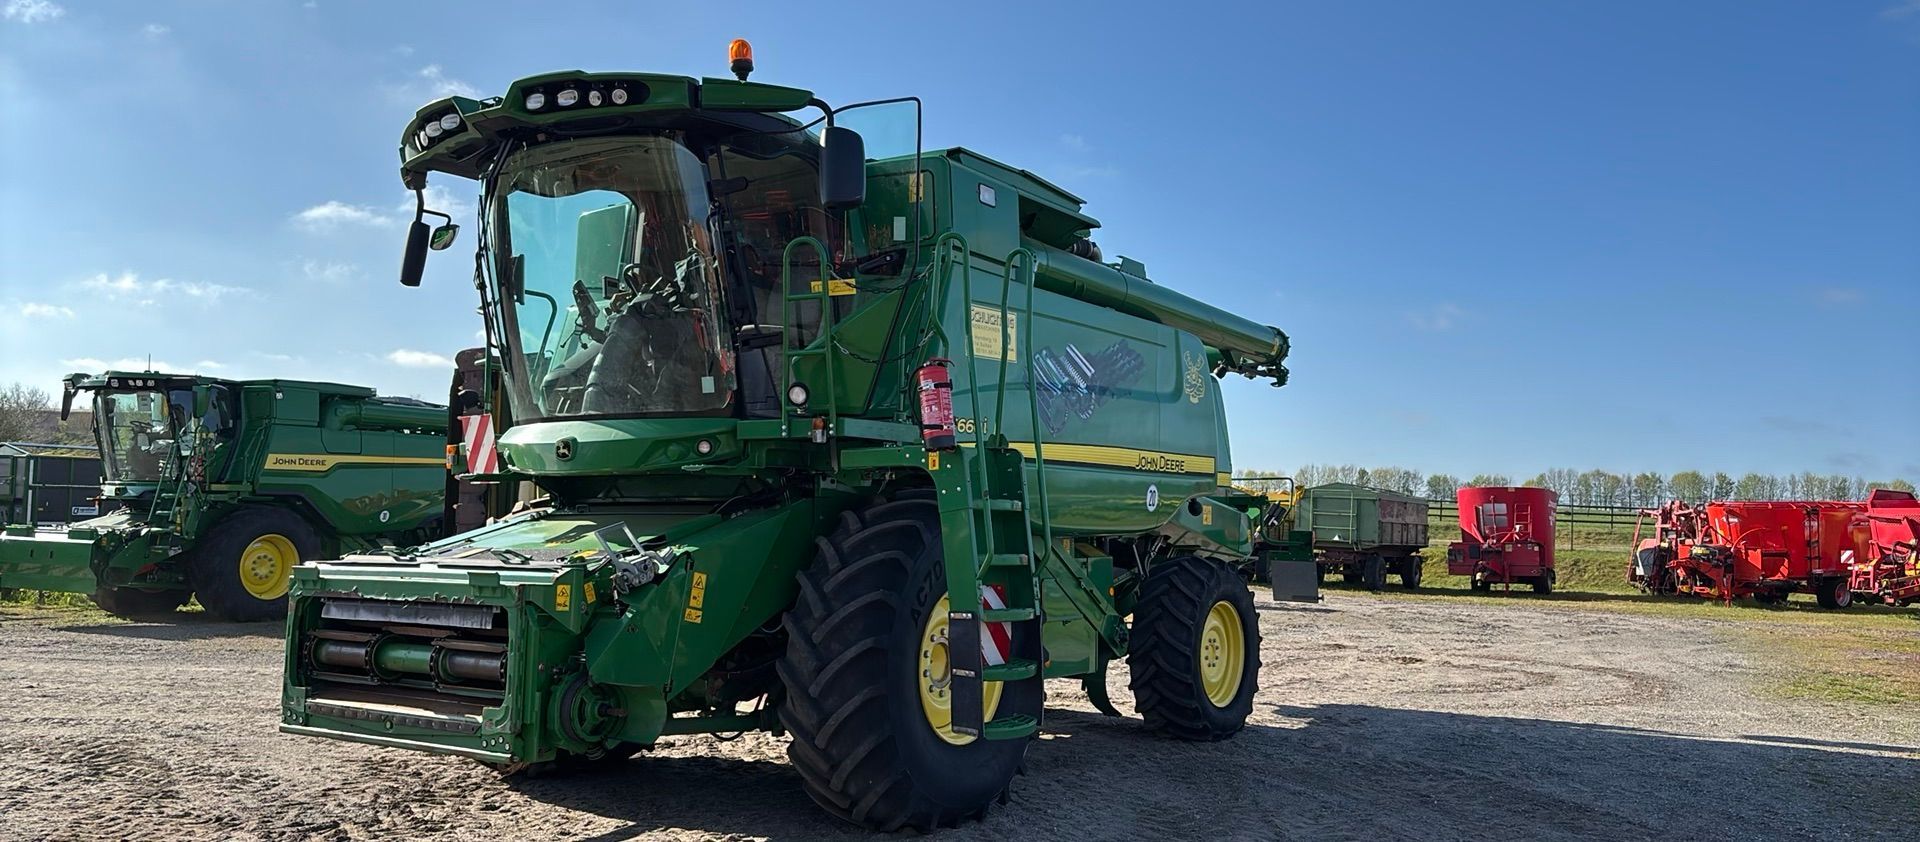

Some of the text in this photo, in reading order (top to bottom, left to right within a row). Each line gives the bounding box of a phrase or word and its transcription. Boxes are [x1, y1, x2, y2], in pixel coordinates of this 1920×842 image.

[272, 457, 327, 466] JOHN DEERE
[1135, 453, 1185, 472] JOHN DEERE
[1148, 489, 1157, 507] 20
